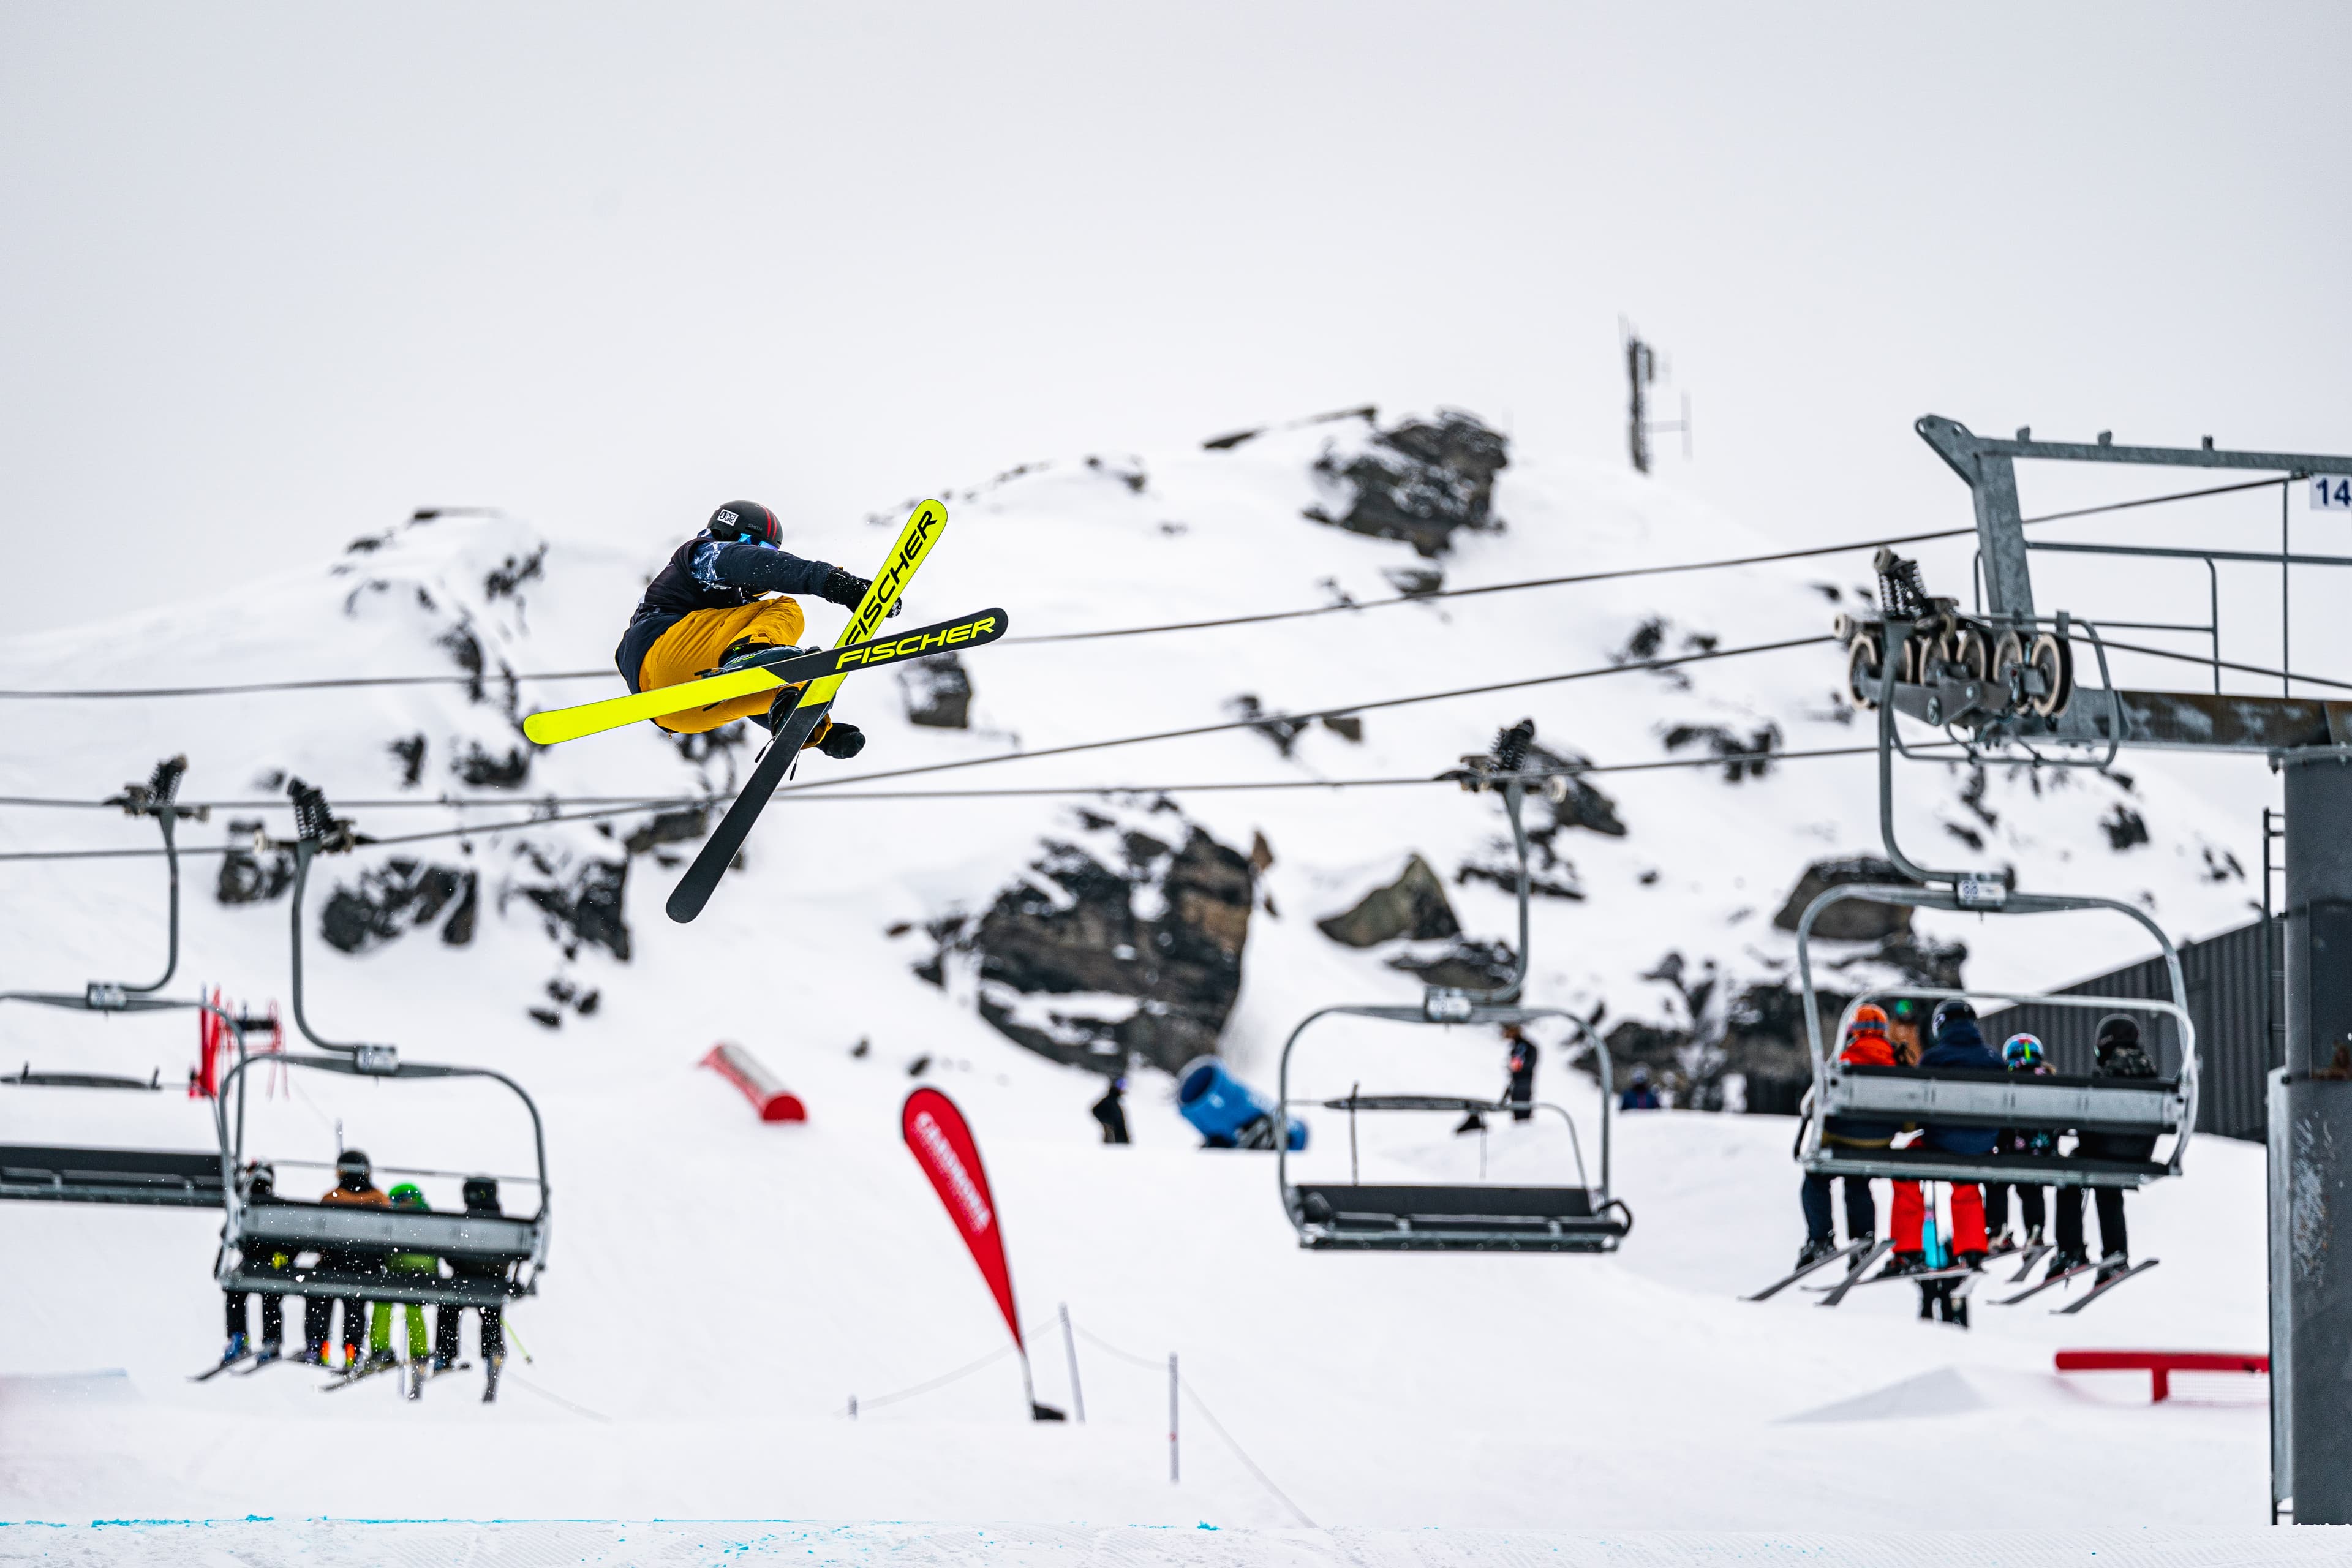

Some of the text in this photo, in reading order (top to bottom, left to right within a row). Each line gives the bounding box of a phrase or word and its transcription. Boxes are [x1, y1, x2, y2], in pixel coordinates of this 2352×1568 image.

[2316, 477, 2351, 507] 14
[845, 510, 938, 646] FISCHER
[835, 616, 996, 671] FISCHER
